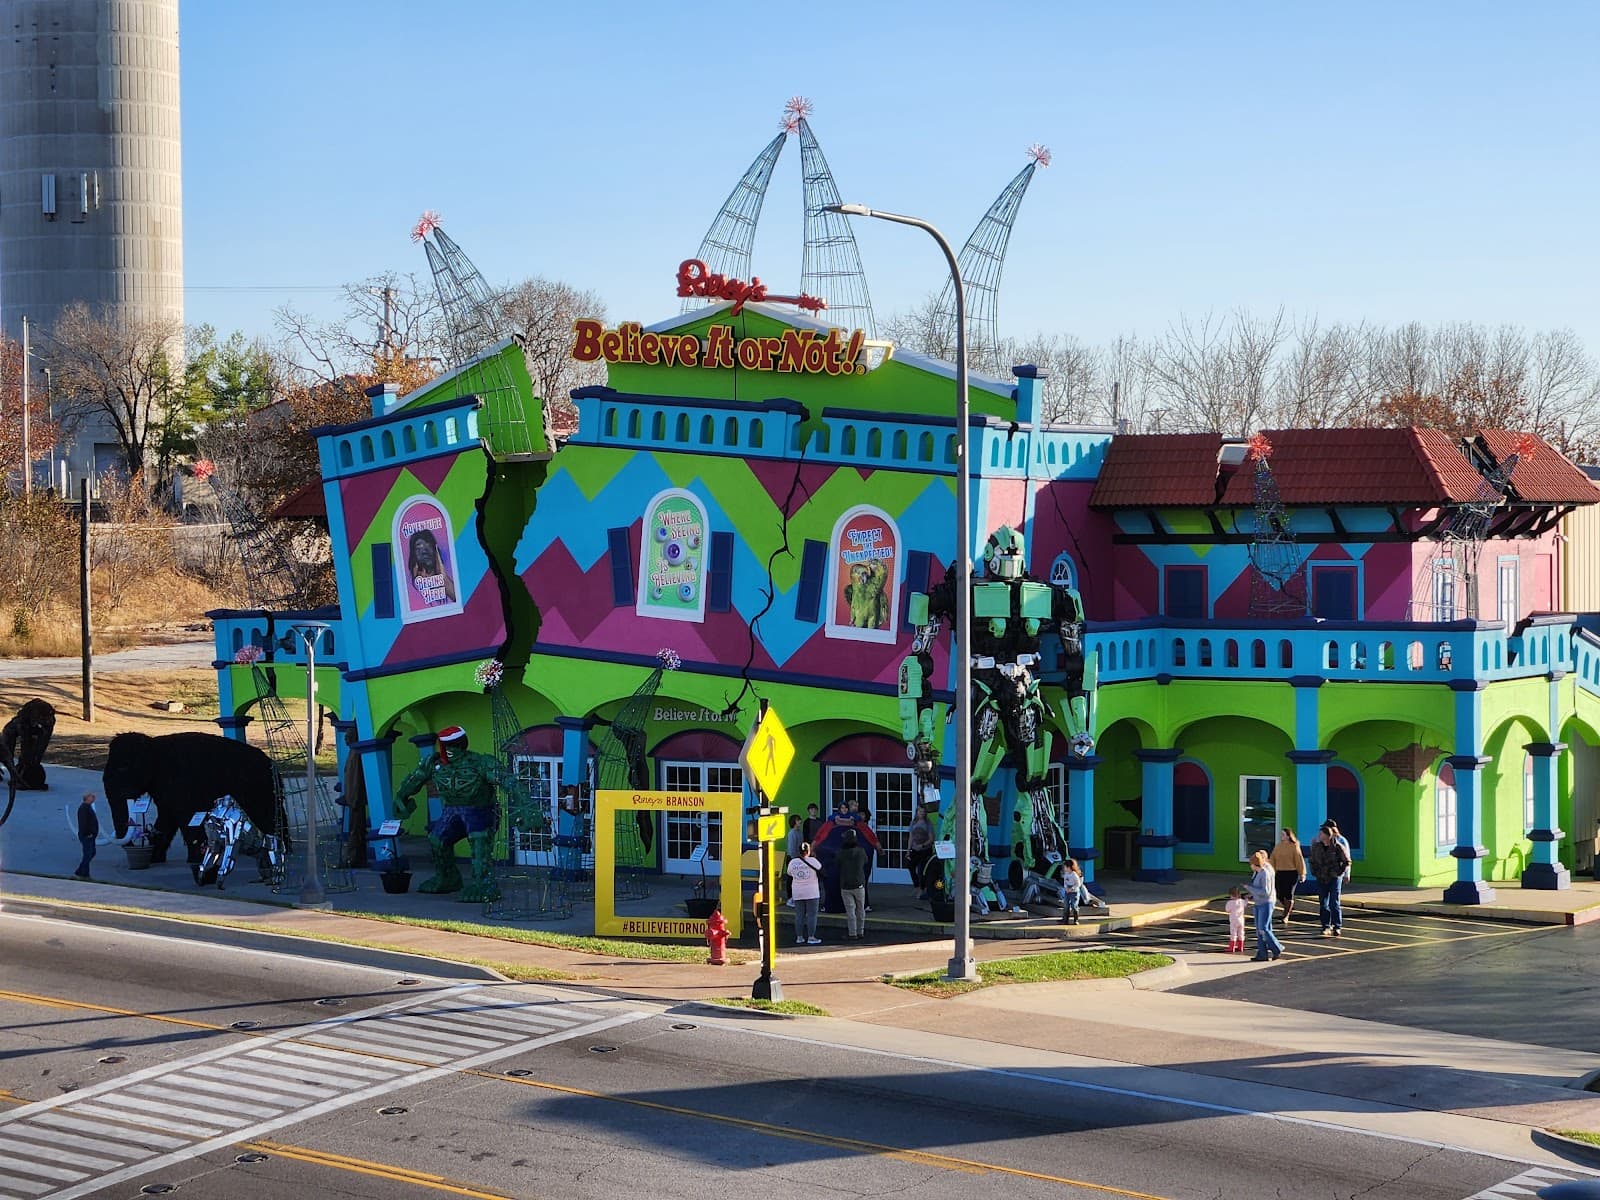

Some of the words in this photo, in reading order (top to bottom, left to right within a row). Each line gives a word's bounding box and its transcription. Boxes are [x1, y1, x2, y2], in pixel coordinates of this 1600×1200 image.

[572, 319, 698, 367] Believe
[703, 324, 735, 369] It
[738, 337, 780, 371] or
[778, 327, 866, 375] Not!
[402, 518, 441, 537] ADVENTURE
[847, 528, 883, 546] EXPECT
[842, 547, 893, 566] UNEXPECTED!
[415, 574, 445, 591] BEGINS
[653, 707, 697, 722] Believe
[698, 708, 711, 722] It
[666, 796, 705, 807] BRANSON
